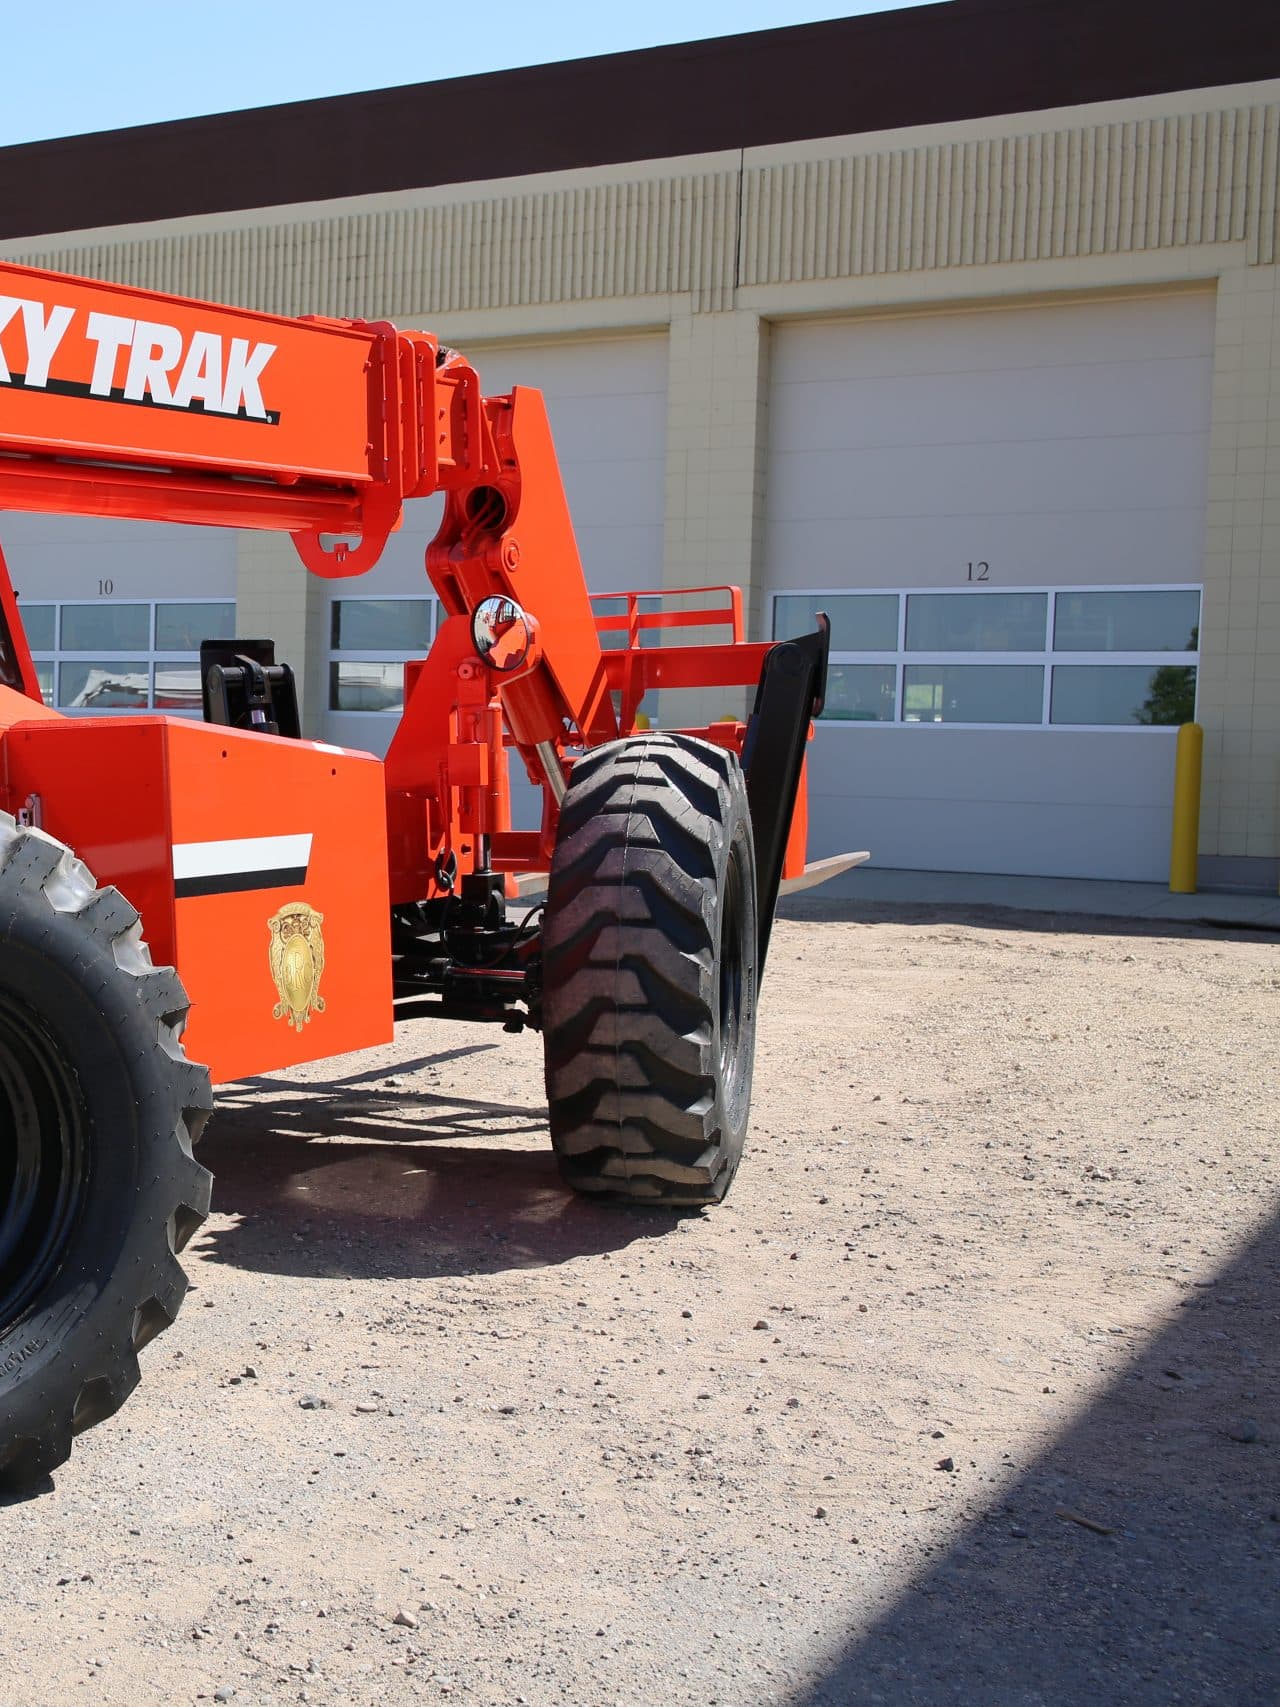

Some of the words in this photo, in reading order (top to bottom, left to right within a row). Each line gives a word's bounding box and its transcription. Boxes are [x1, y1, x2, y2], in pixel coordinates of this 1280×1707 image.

[84, 311, 277, 419] TRAK
[967, 561, 990, 582] 12
[98, 579, 114, 596] 10
